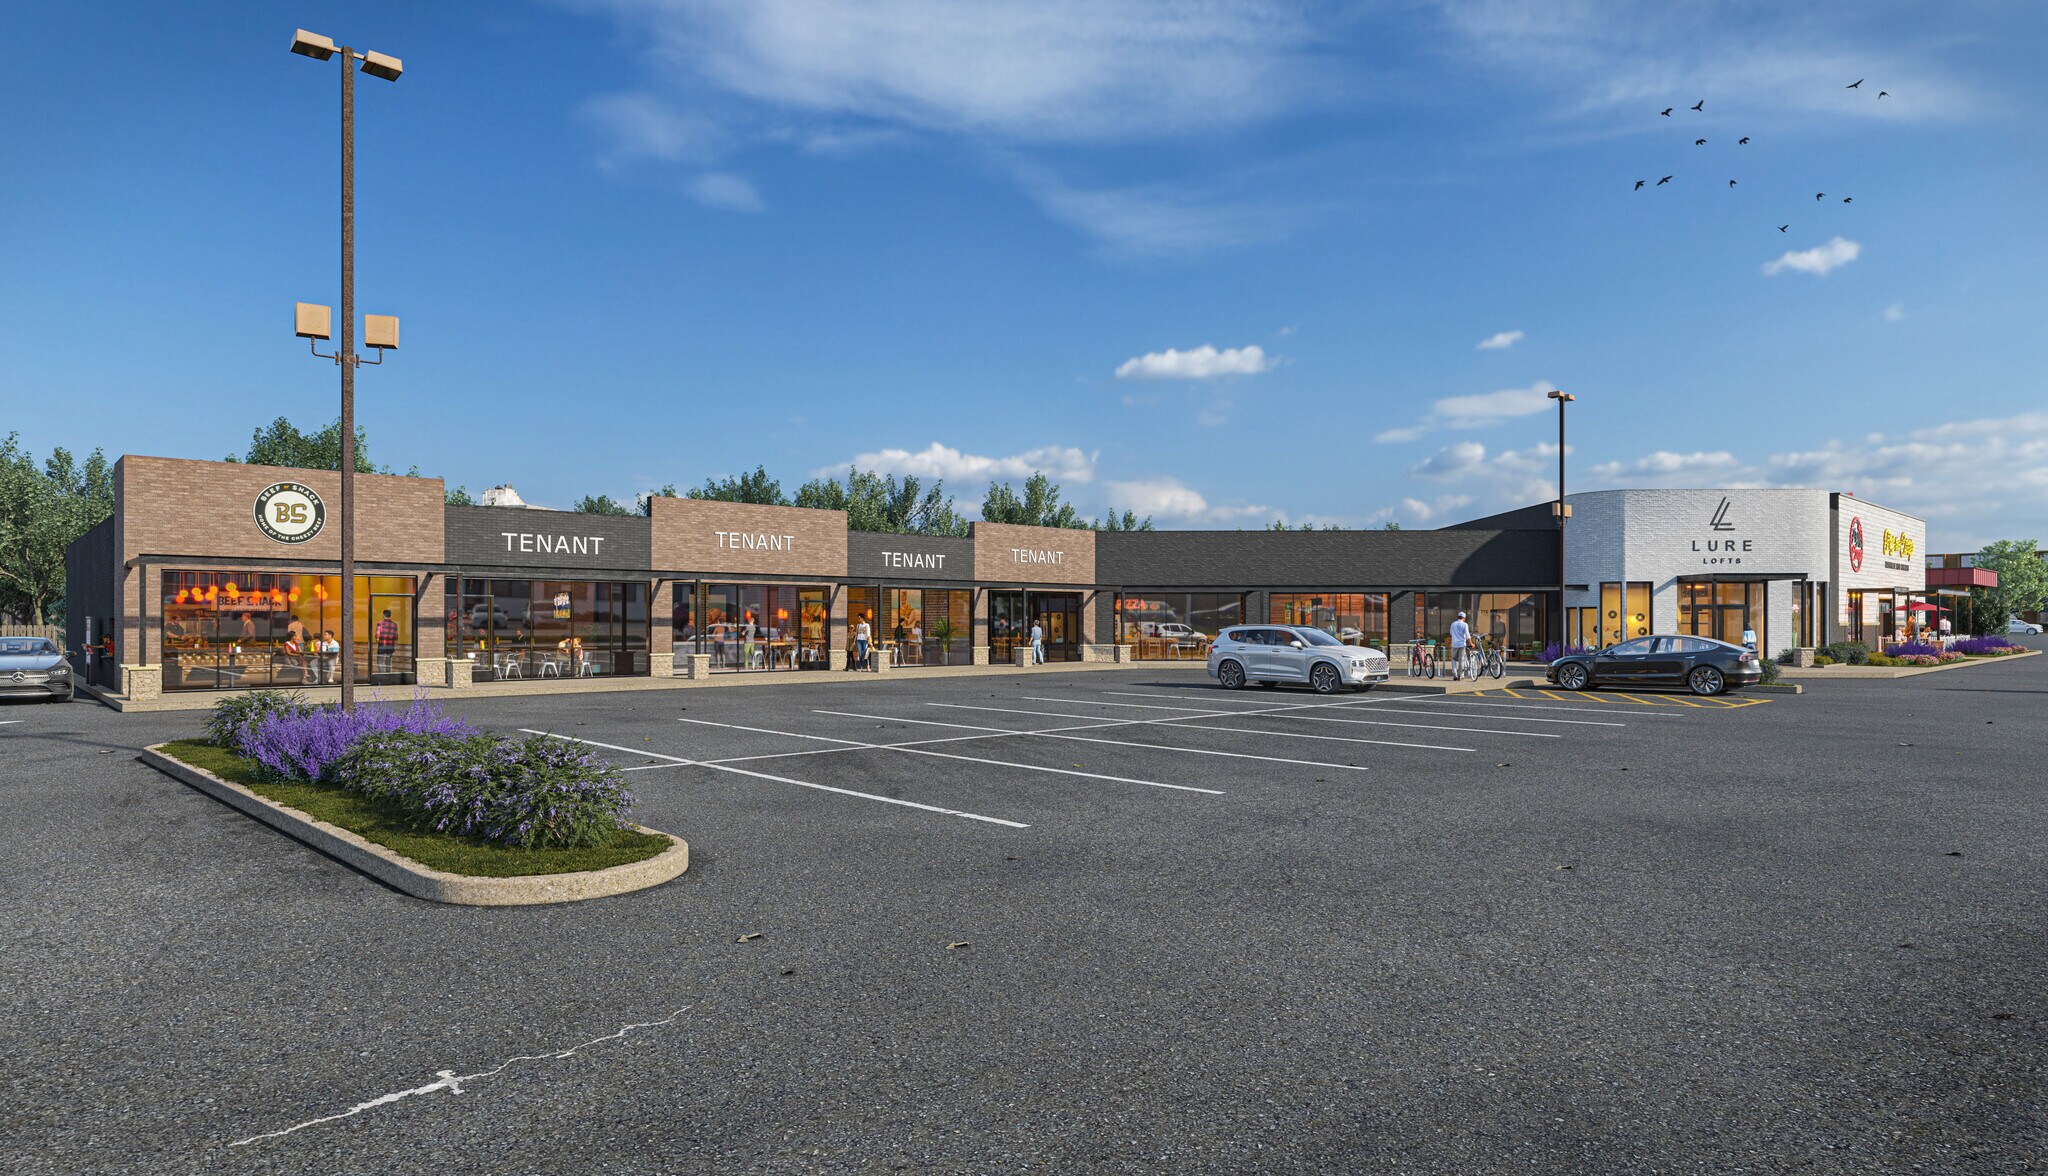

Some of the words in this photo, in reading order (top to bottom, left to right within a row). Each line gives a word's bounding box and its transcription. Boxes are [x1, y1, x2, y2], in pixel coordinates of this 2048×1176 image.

[260, 485, 281, 501] BEEF
[292, 485, 320, 505] SHACK
[274, 502, 308, 524] BS
[258, 514, 270, 530] HOME
[502, 532, 604, 555] TENANT
[714, 531, 795, 552] TENANT
[1692, 540, 1753, 552] LURE
[882, 551, 946, 568] TENANT
[1011, 548, 1064, 565] TENANT
[1703, 557, 1742, 565] LOFTS
[218, 596, 244, 606] BEEF
